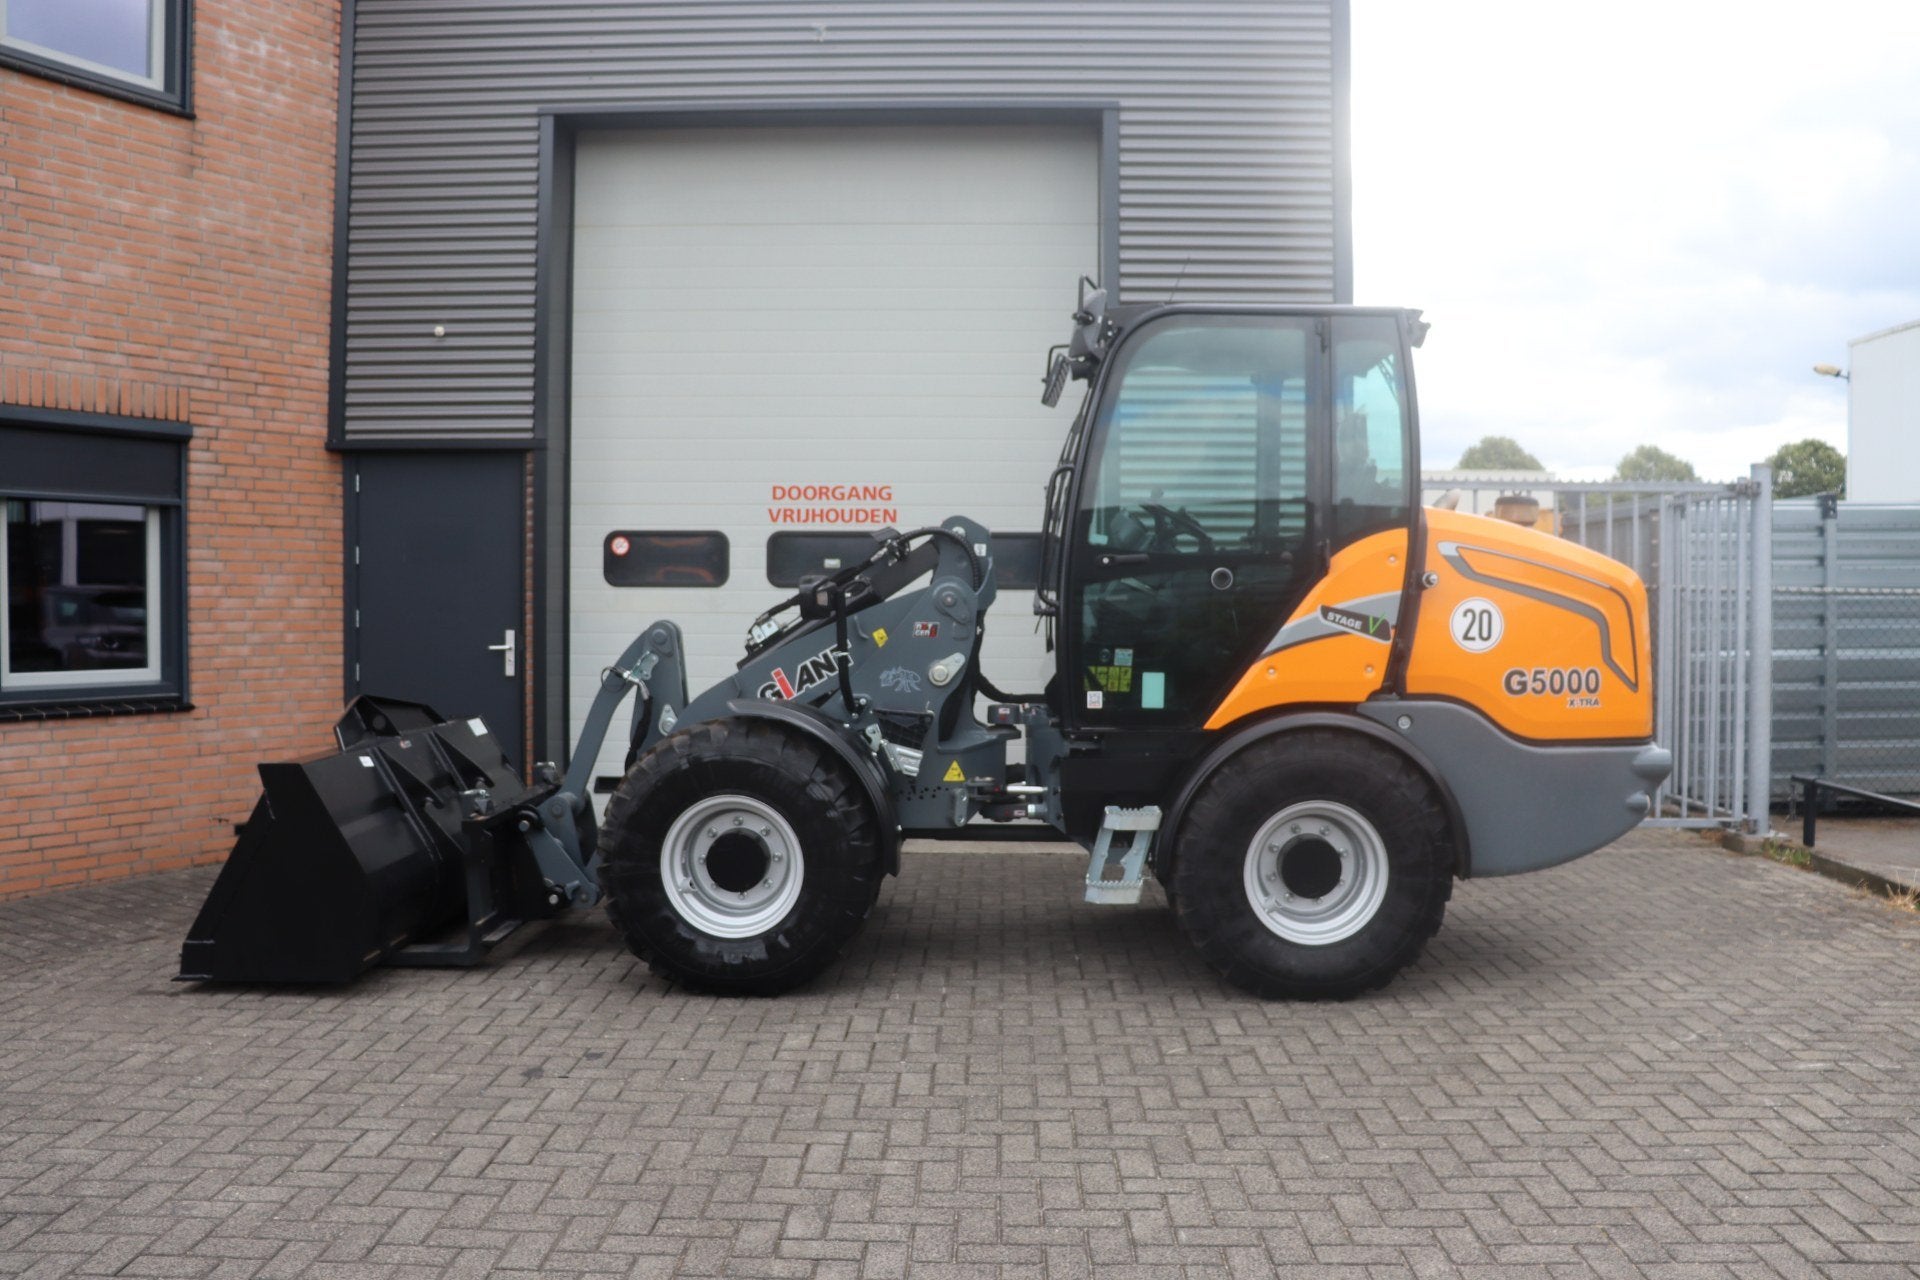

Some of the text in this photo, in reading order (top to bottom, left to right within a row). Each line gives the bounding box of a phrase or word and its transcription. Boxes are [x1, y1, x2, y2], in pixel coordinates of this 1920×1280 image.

[771, 485, 892, 501] DOORGANG
[767, 508, 897, 523] VRIJHOUDEN
[1327, 611, 1387, 634] STAGE V
[1462, 608, 1493, 642] 20
[1503, 667, 1601, 696] G5000
